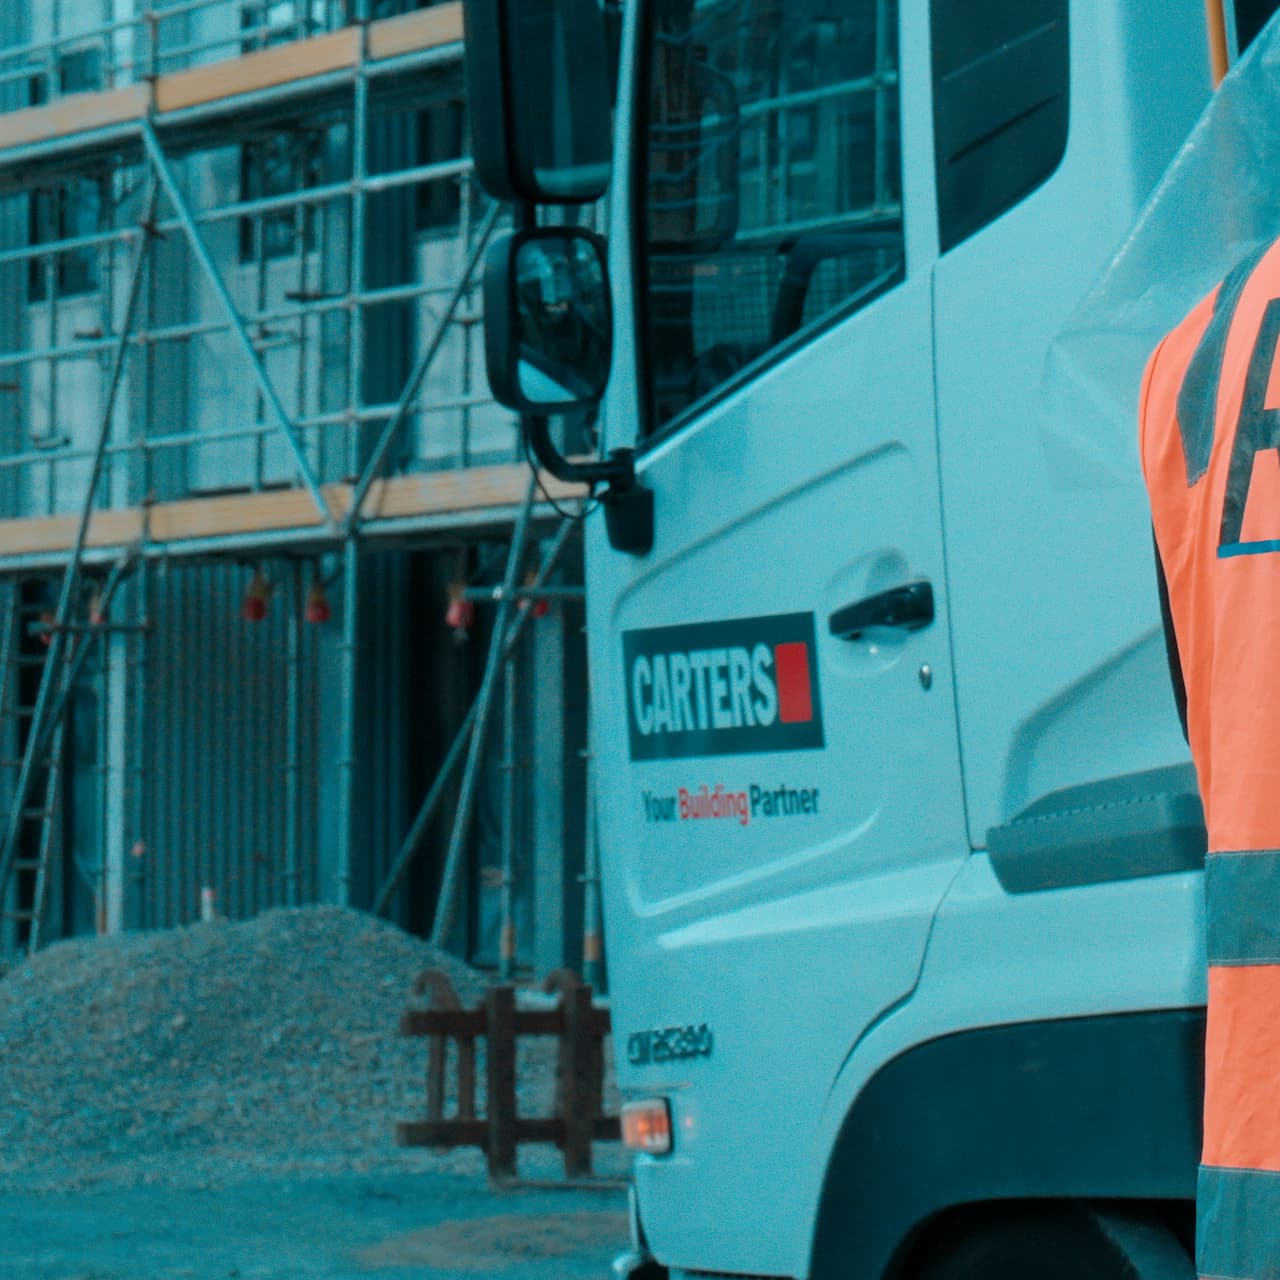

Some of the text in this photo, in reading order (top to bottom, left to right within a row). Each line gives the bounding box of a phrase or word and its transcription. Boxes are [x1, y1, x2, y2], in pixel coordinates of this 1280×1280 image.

[632, 642, 778, 735] CARTERS
[642, 784, 819, 826] Your Building Partner
